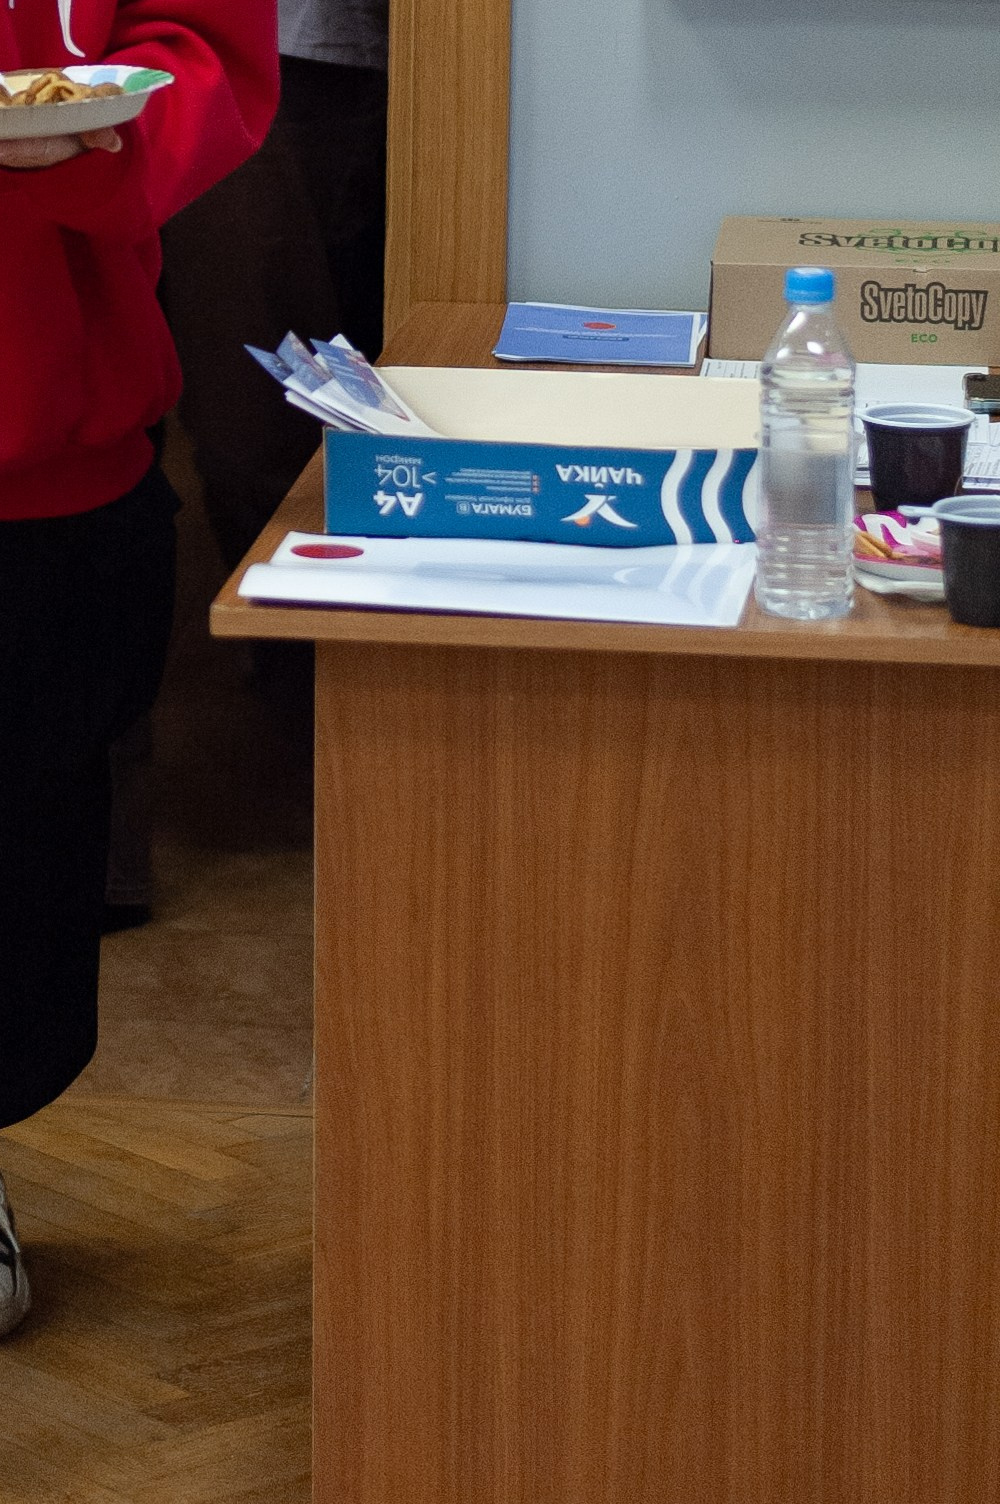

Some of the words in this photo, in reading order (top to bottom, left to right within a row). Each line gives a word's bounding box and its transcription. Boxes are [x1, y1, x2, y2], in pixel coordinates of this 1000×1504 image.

[798, 232, 1000, 253] SvetoCo
[860, 280, 989, 331] SvetoCopy
[911, 333, 938, 343] ECO
[555, 463, 643, 488] ЧАЙКА
[373, 490, 423, 516] A4
[471, 502, 532, 515] БУМАГА
